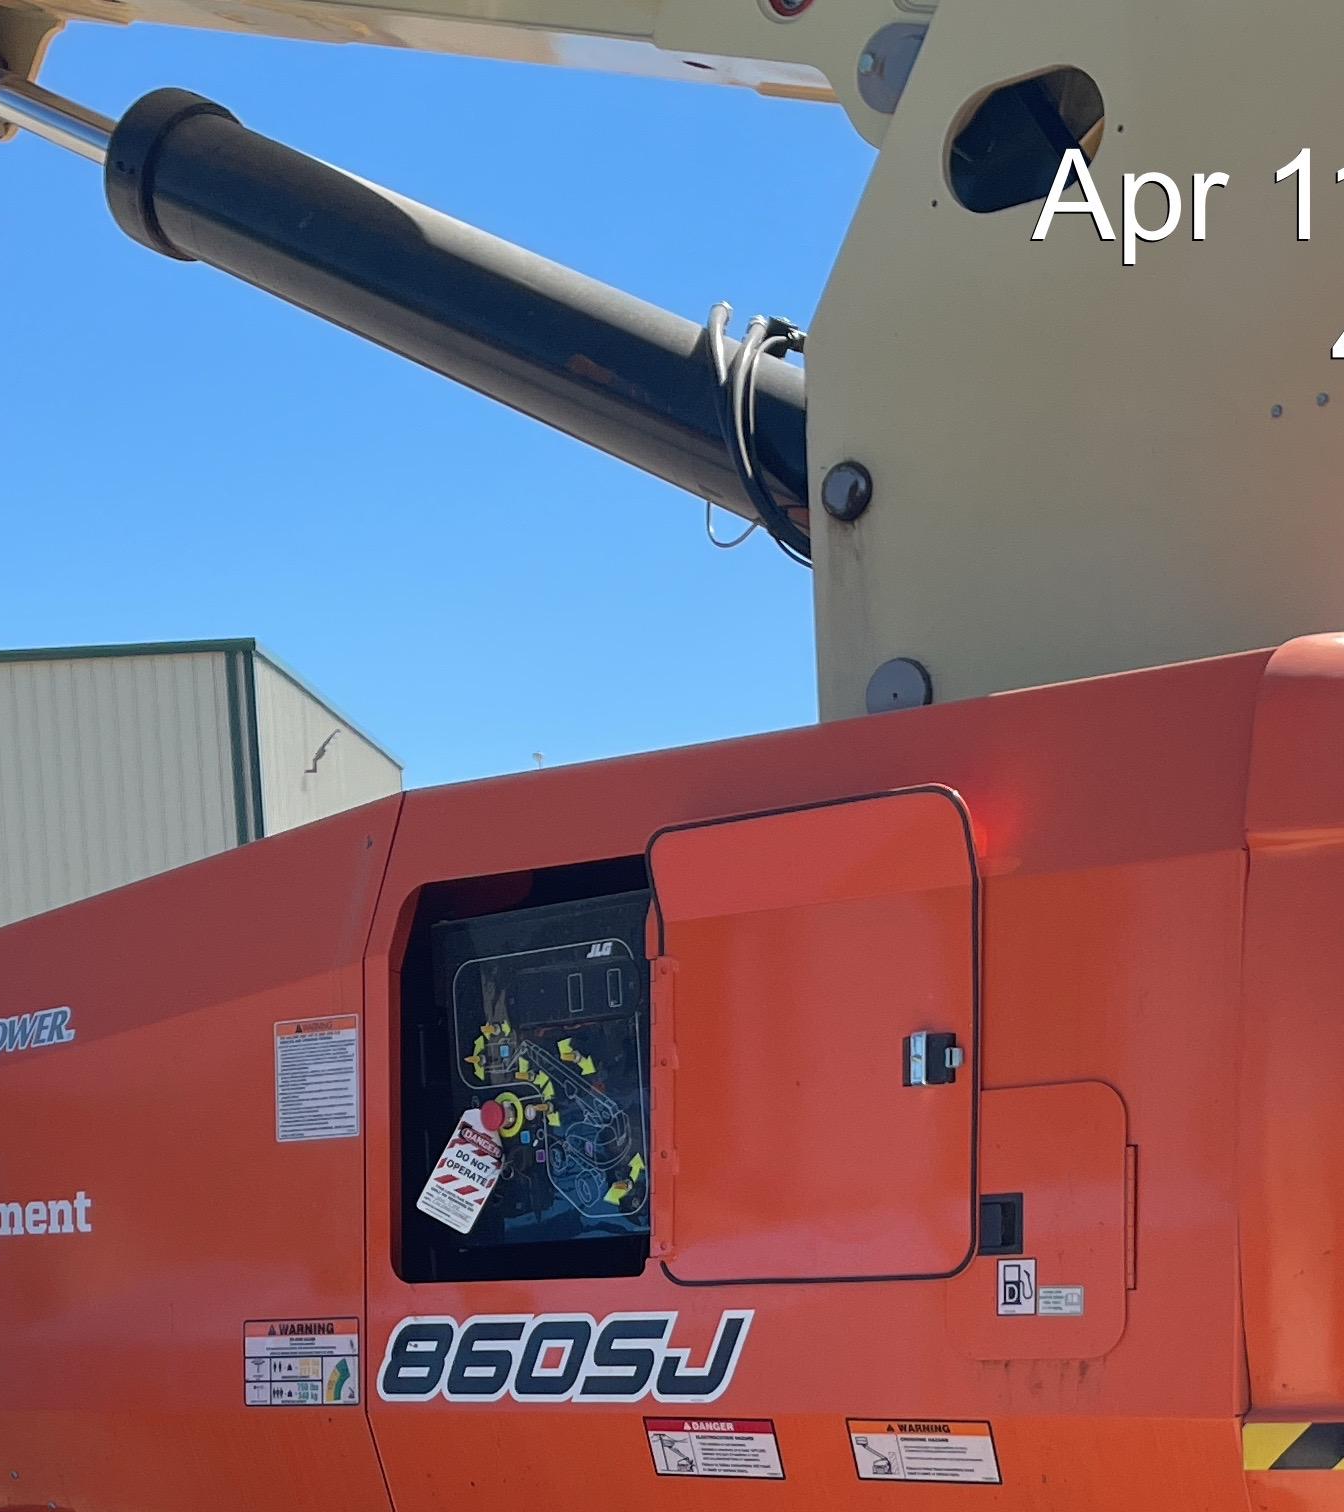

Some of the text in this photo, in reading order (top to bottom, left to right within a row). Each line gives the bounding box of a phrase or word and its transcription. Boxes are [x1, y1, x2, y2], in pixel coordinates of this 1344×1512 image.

[586, 942, 613, 959] JLG
[464, 1130, 502, 1159] DANGER
[456, 1149, 491, 1173] DO NOT
[446, 1159, 488, 1187] OPERATE
[279, 1322, 335, 1336] WARNING
[378, 1312, 752, 1400] 860SJ
[691, 1421, 735, 1432] DANGER
[897, 1423, 951, 1434] WARNING
